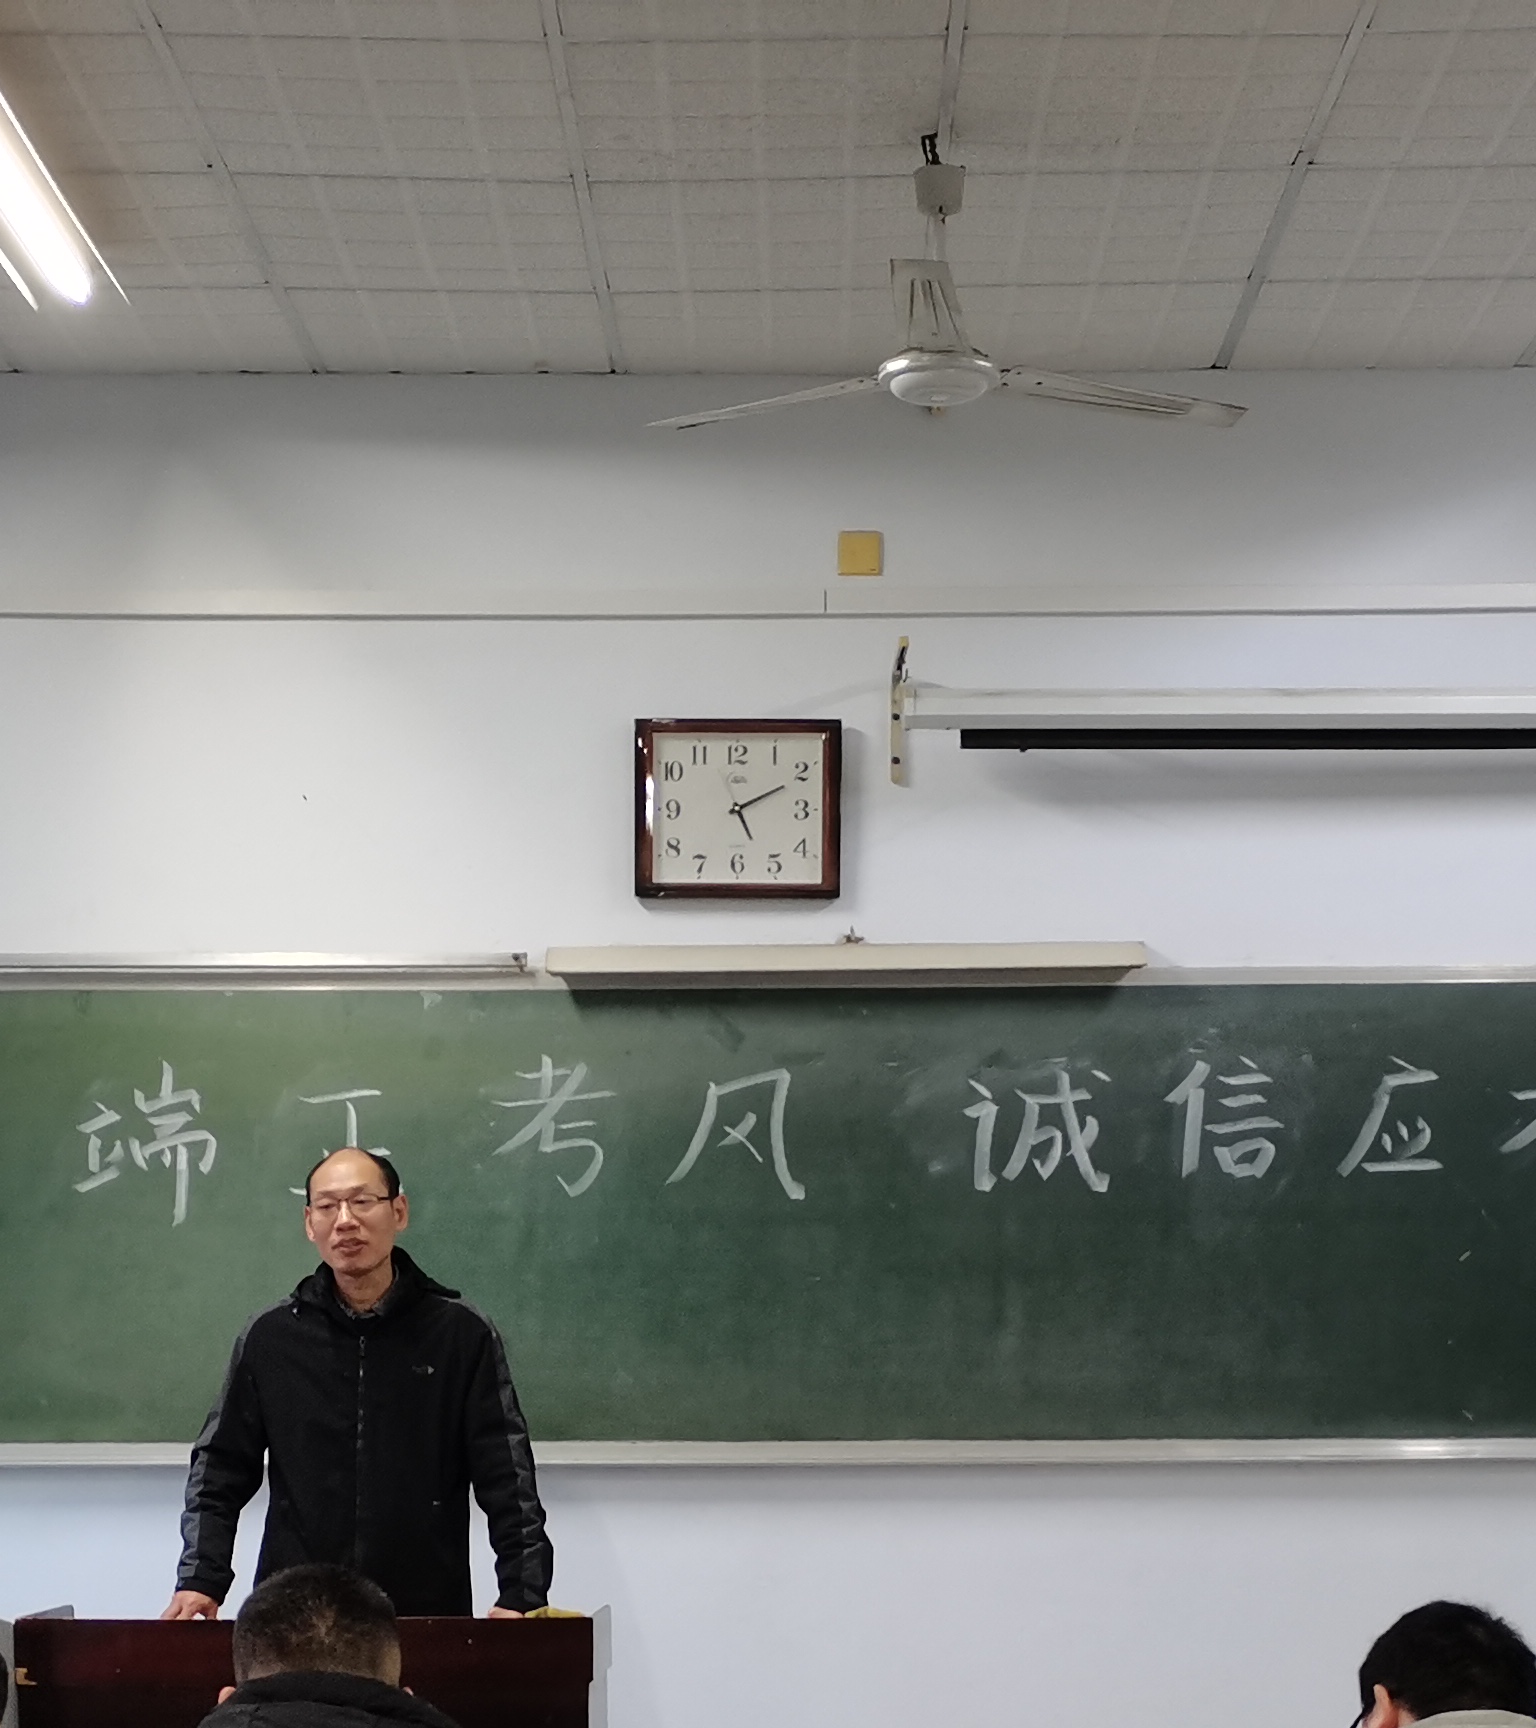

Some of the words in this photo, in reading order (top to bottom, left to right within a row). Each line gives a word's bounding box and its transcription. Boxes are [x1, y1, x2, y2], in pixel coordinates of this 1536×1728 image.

[692, 745, 707, 765] 11
[727, 744, 748, 765] 12
[772, 745, 777, 766] 1
[664, 760, 683, 781] 10
[794, 761, 809, 781] 2
[666, 799, 681, 820] 9
[794, 799, 809, 820] 3
[665, 837, 681, 858] 8
[793, 838, 808, 858] 4
[692, 854, 707, 874] 7
[730, 853, 744, 874] 6
[767, 853, 782, 874] 5
